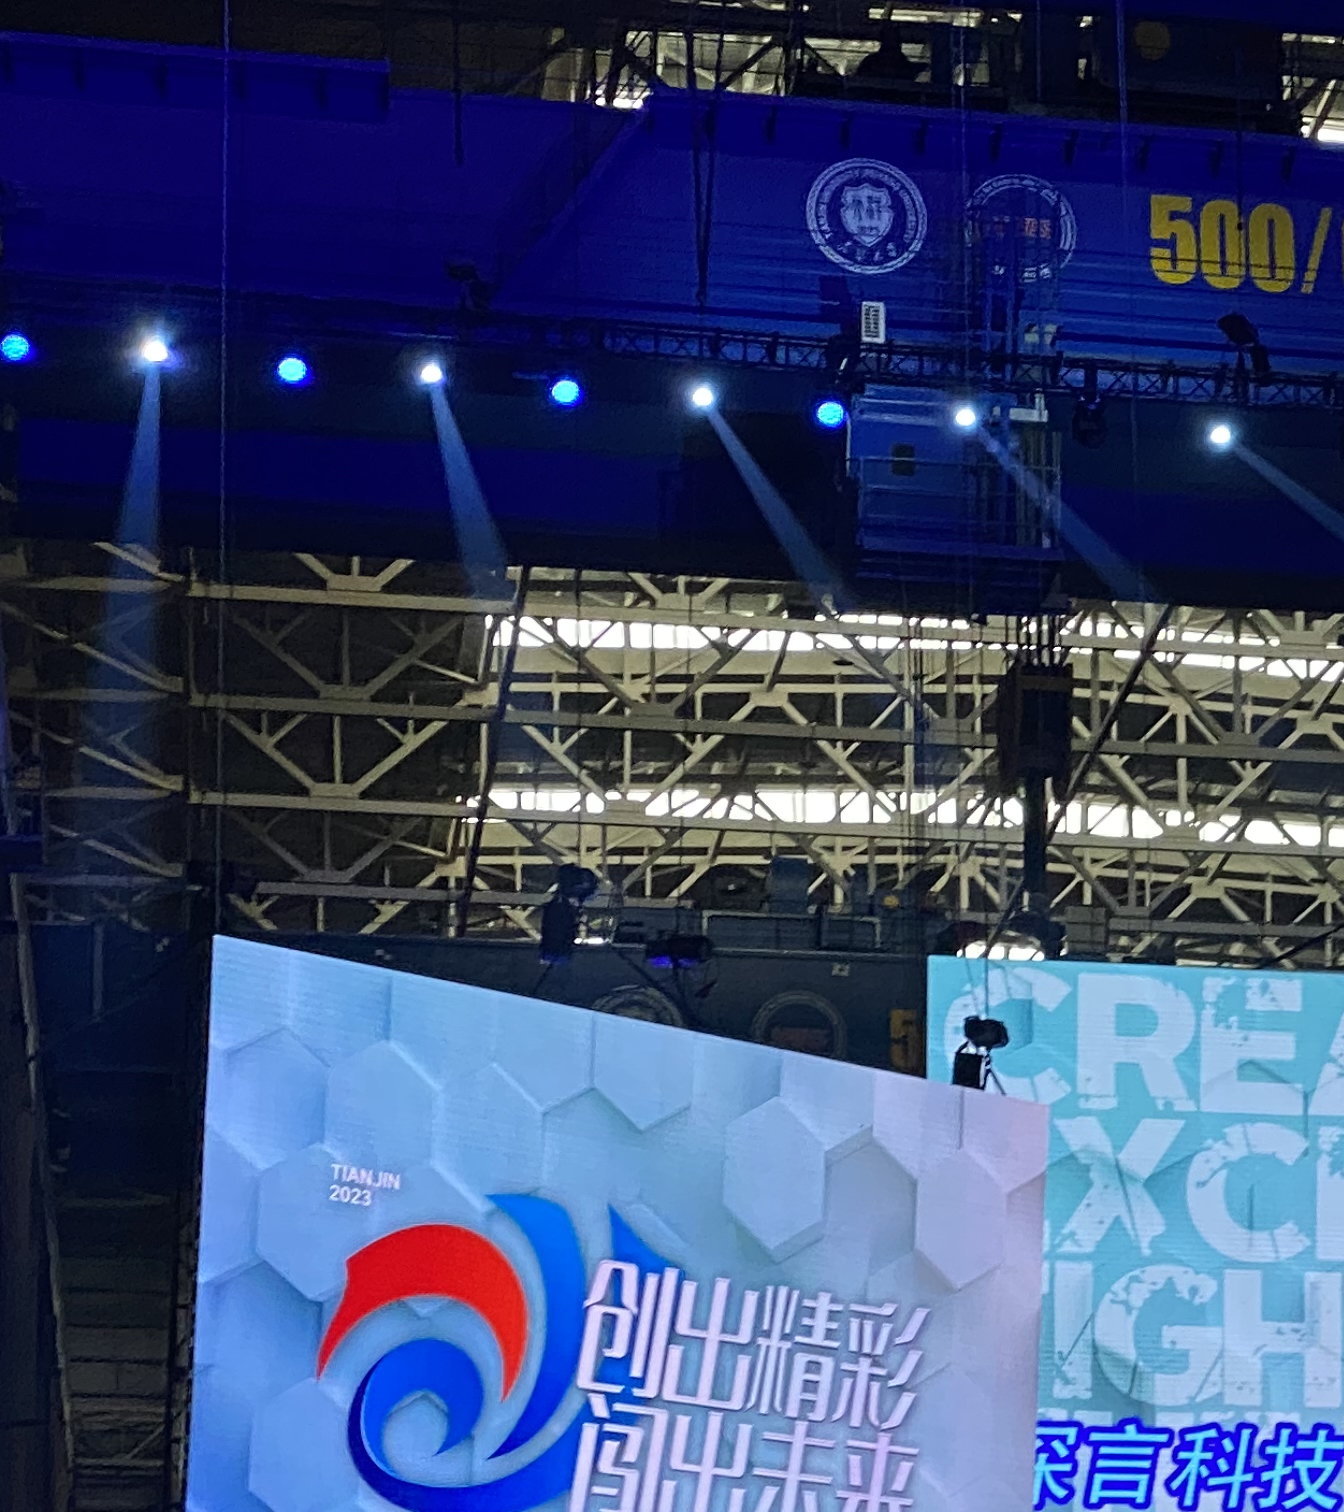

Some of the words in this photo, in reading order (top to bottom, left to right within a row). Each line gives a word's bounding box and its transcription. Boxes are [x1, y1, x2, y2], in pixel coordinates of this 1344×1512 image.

[331, 1162, 400, 1191] TIANJIN
[329, 1184, 372, 1206] 2023
[578, 1257, 931, 1431] 创出精彩
